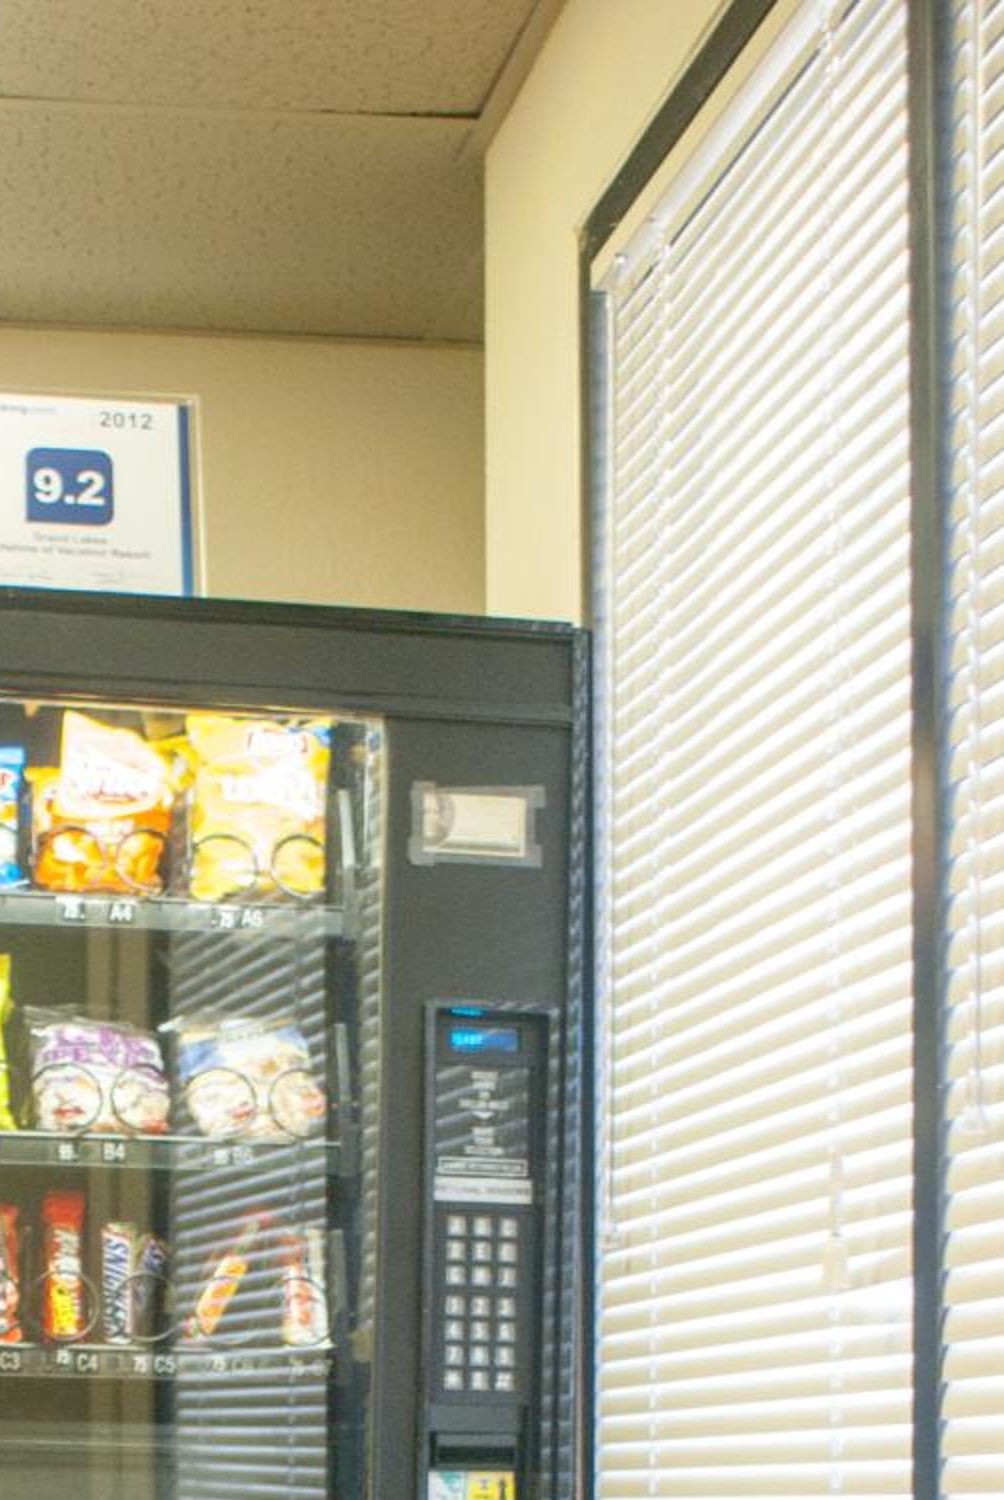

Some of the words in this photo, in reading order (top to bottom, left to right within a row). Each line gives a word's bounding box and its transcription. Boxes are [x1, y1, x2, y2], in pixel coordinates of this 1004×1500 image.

[99, 410, 153, 431] 2012
[32, 466, 106, 507] 9.2
[76, 1352, 99, 1374] C4
[154, 1354, 177, 1374] C5
